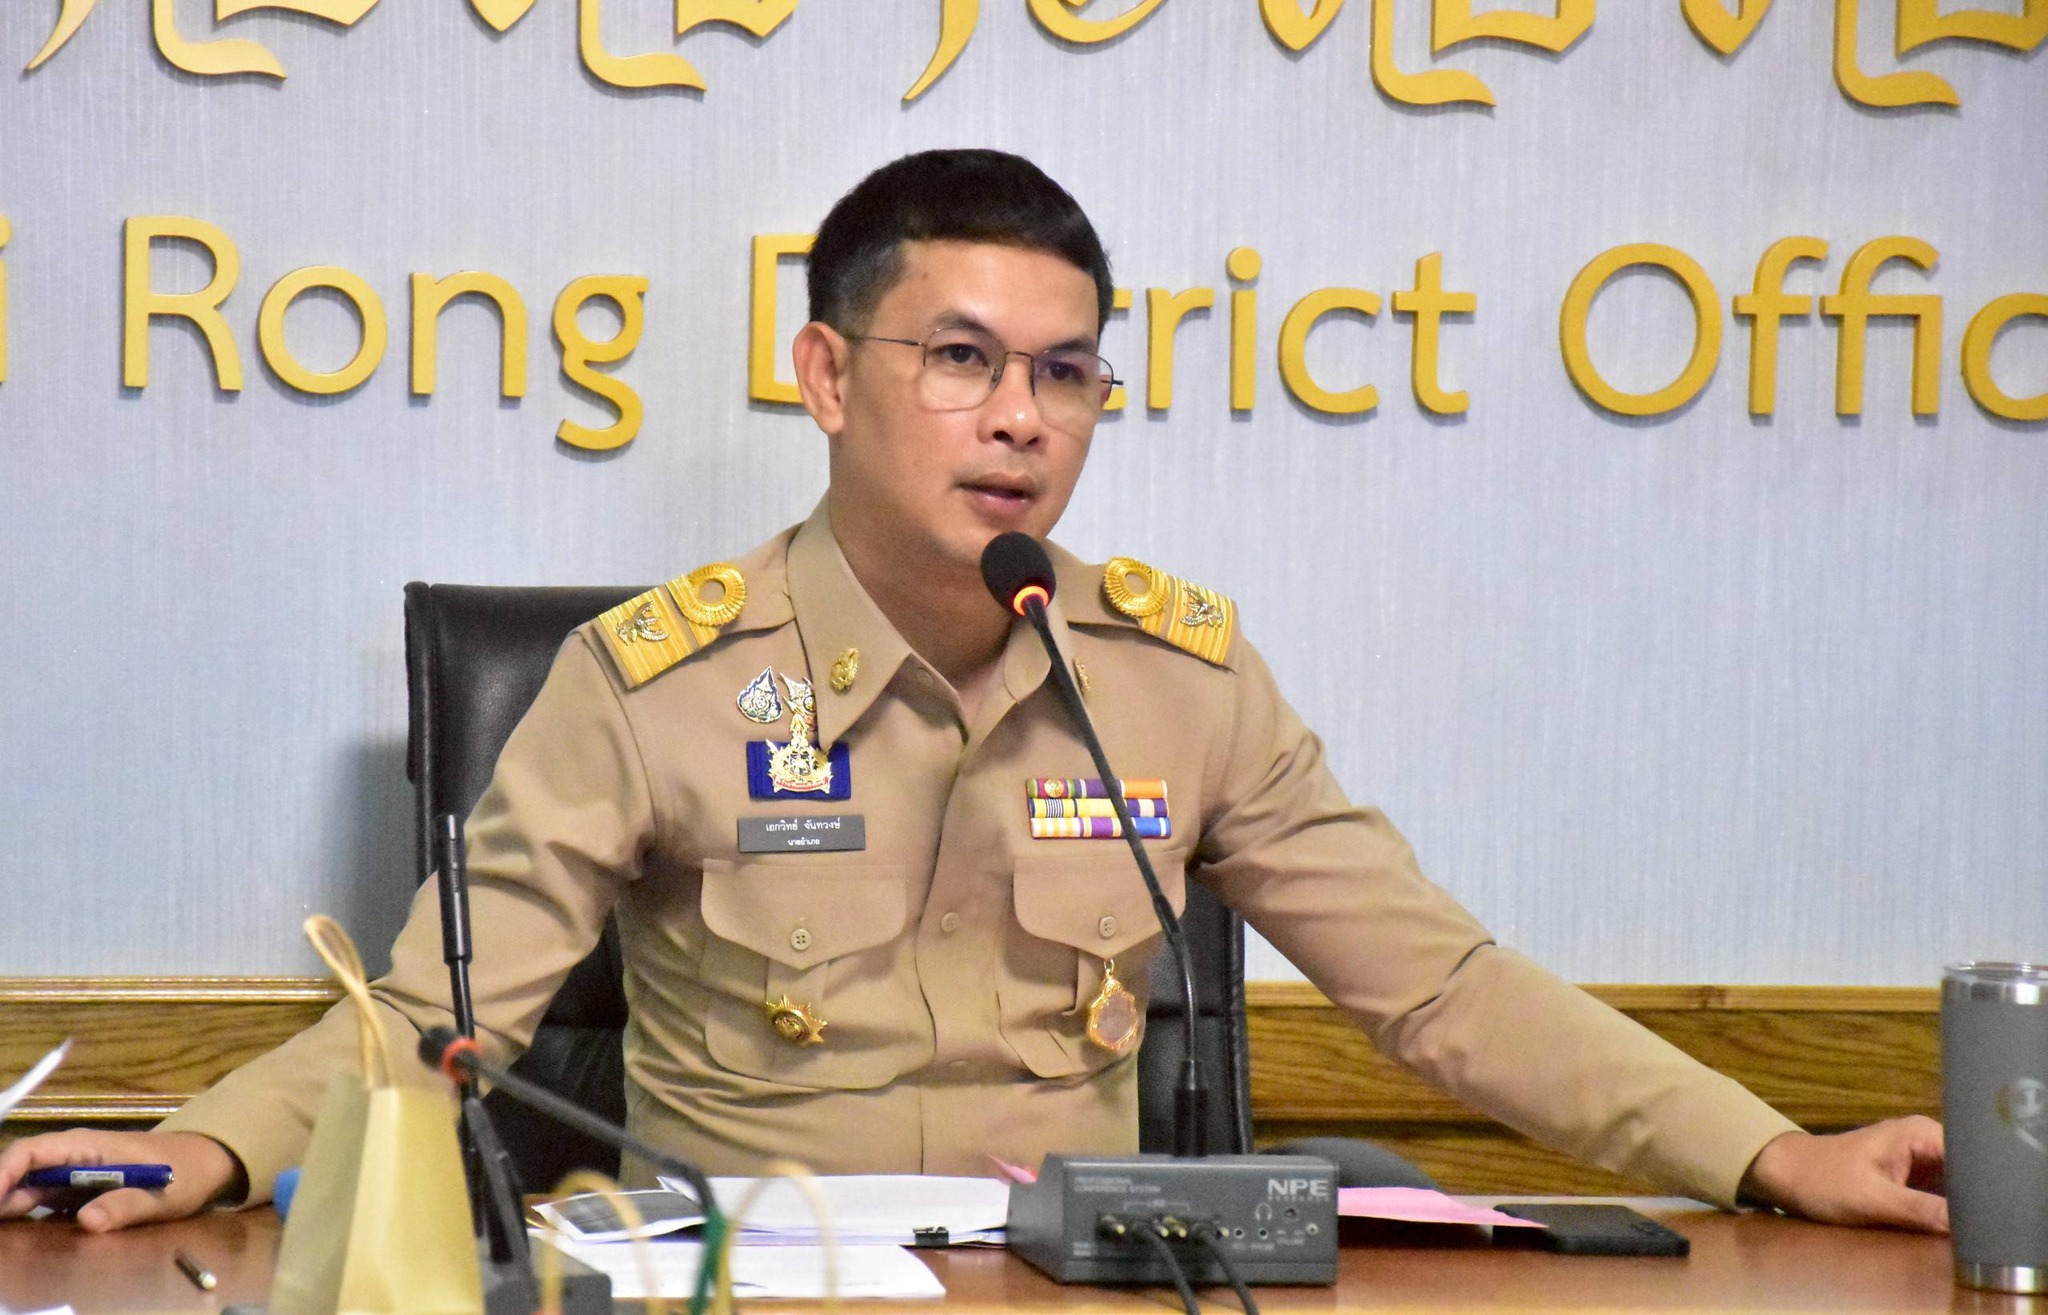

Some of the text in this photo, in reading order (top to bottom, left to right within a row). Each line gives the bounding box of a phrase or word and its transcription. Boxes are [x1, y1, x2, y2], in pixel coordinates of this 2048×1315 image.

[124, 215, 650, 451] Rong
[766, 818, 798, 831] เอกวิทย์
[1267, 1178, 1329, 1196] NPE
